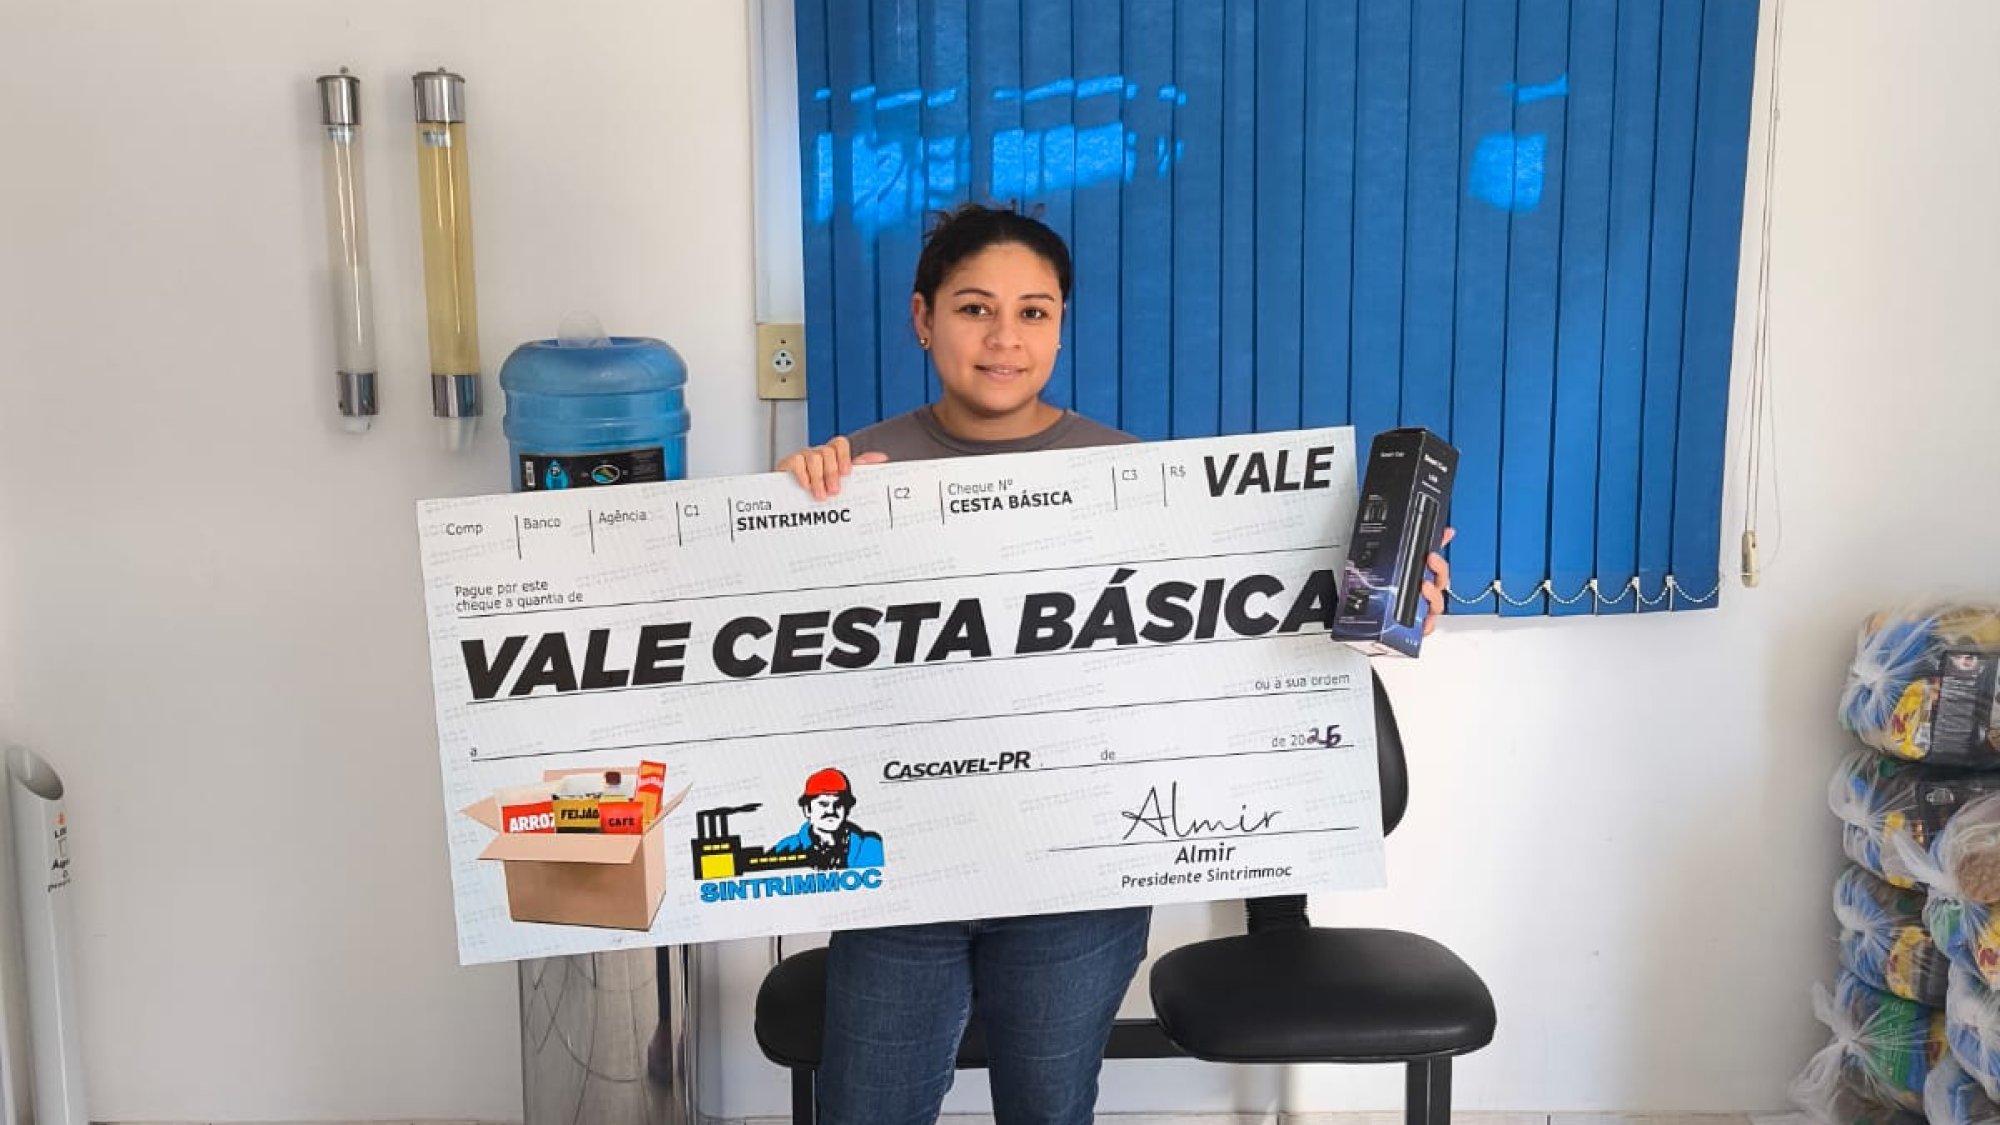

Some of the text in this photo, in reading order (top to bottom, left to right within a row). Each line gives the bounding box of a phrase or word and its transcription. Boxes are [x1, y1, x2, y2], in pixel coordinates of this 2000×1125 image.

[1122, 469, 1137, 481] C3
[1170, 466, 1185, 478] R$
[1204, 446, 1335, 497] VALE
[894, 487, 910, 499] C2
[948, 480, 994, 496] Cheque
[684, 505, 700, 517] C1
[736, 499, 772, 512] Conta
[949, 490, 1073, 513] CESTA BÁSICA
[523, 516, 561, 529] Banco
[599, 508, 647, 525] Agência
[737, 509, 851, 532] SINTRIMMOC
[446, 522, 483, 537] Comp
[455, 579, 548, 599] Pague por este
[456, 590, 583, 613] cheque a quantia de
[461, 568, 1340, 700] VALE CESTA BÁSICA
[1255, 680, 1270, 691] ou
[1285, 677, 1306, 688] sua
[1311, 673, 1350, 686] ordem
[1101, 748, 1116, 761] de
[1272, 737, 1286, 747] de
[1121, 781, 1282, 840] Almir
[1175, 844, 1235, 864] Almir
[699, 869, 882, 903] SINTRIMMOC
[1122, 865, 1292, 889] Presidente Sintrimmoc
